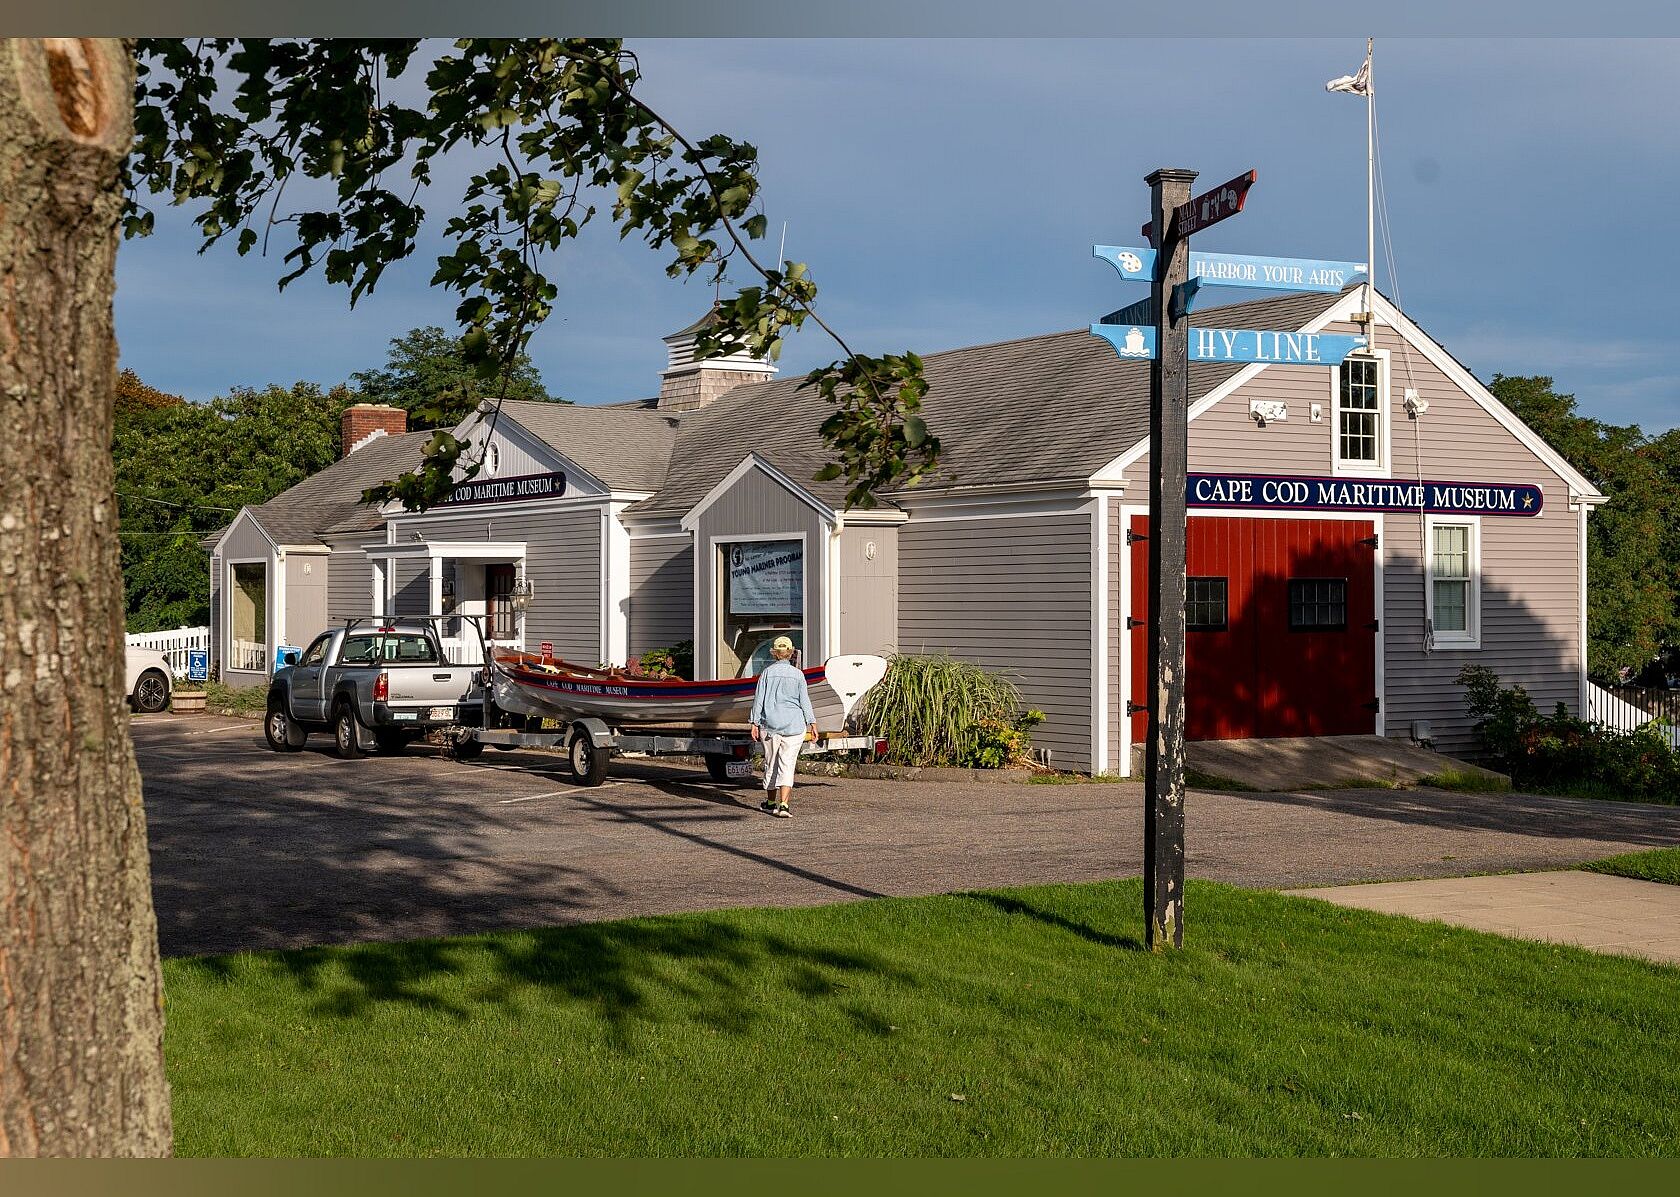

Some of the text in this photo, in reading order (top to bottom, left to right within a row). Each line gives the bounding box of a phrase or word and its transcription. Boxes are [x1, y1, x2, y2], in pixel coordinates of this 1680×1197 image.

[1178, 199, 1197, 222] MAIN
[1178, 215, 1198, 237] STREET
[1195, 261, 1344, 287] HARBOR YOUR ARTS
[455, 484, 472, 501] COD
[473, 482, 515, 500] MARITIME
[517, 478, 552, 495] MUSEUM
[1195, 478, 1516, 510] CAPE COD MARITIME MUSEUM
[732, 567, 750, 578] YOUNG
[751, 560, 775, 573] MARINER
[576, 684, 602, 693] MARITIME
[605, 686, 628, 696] MUSEUM
